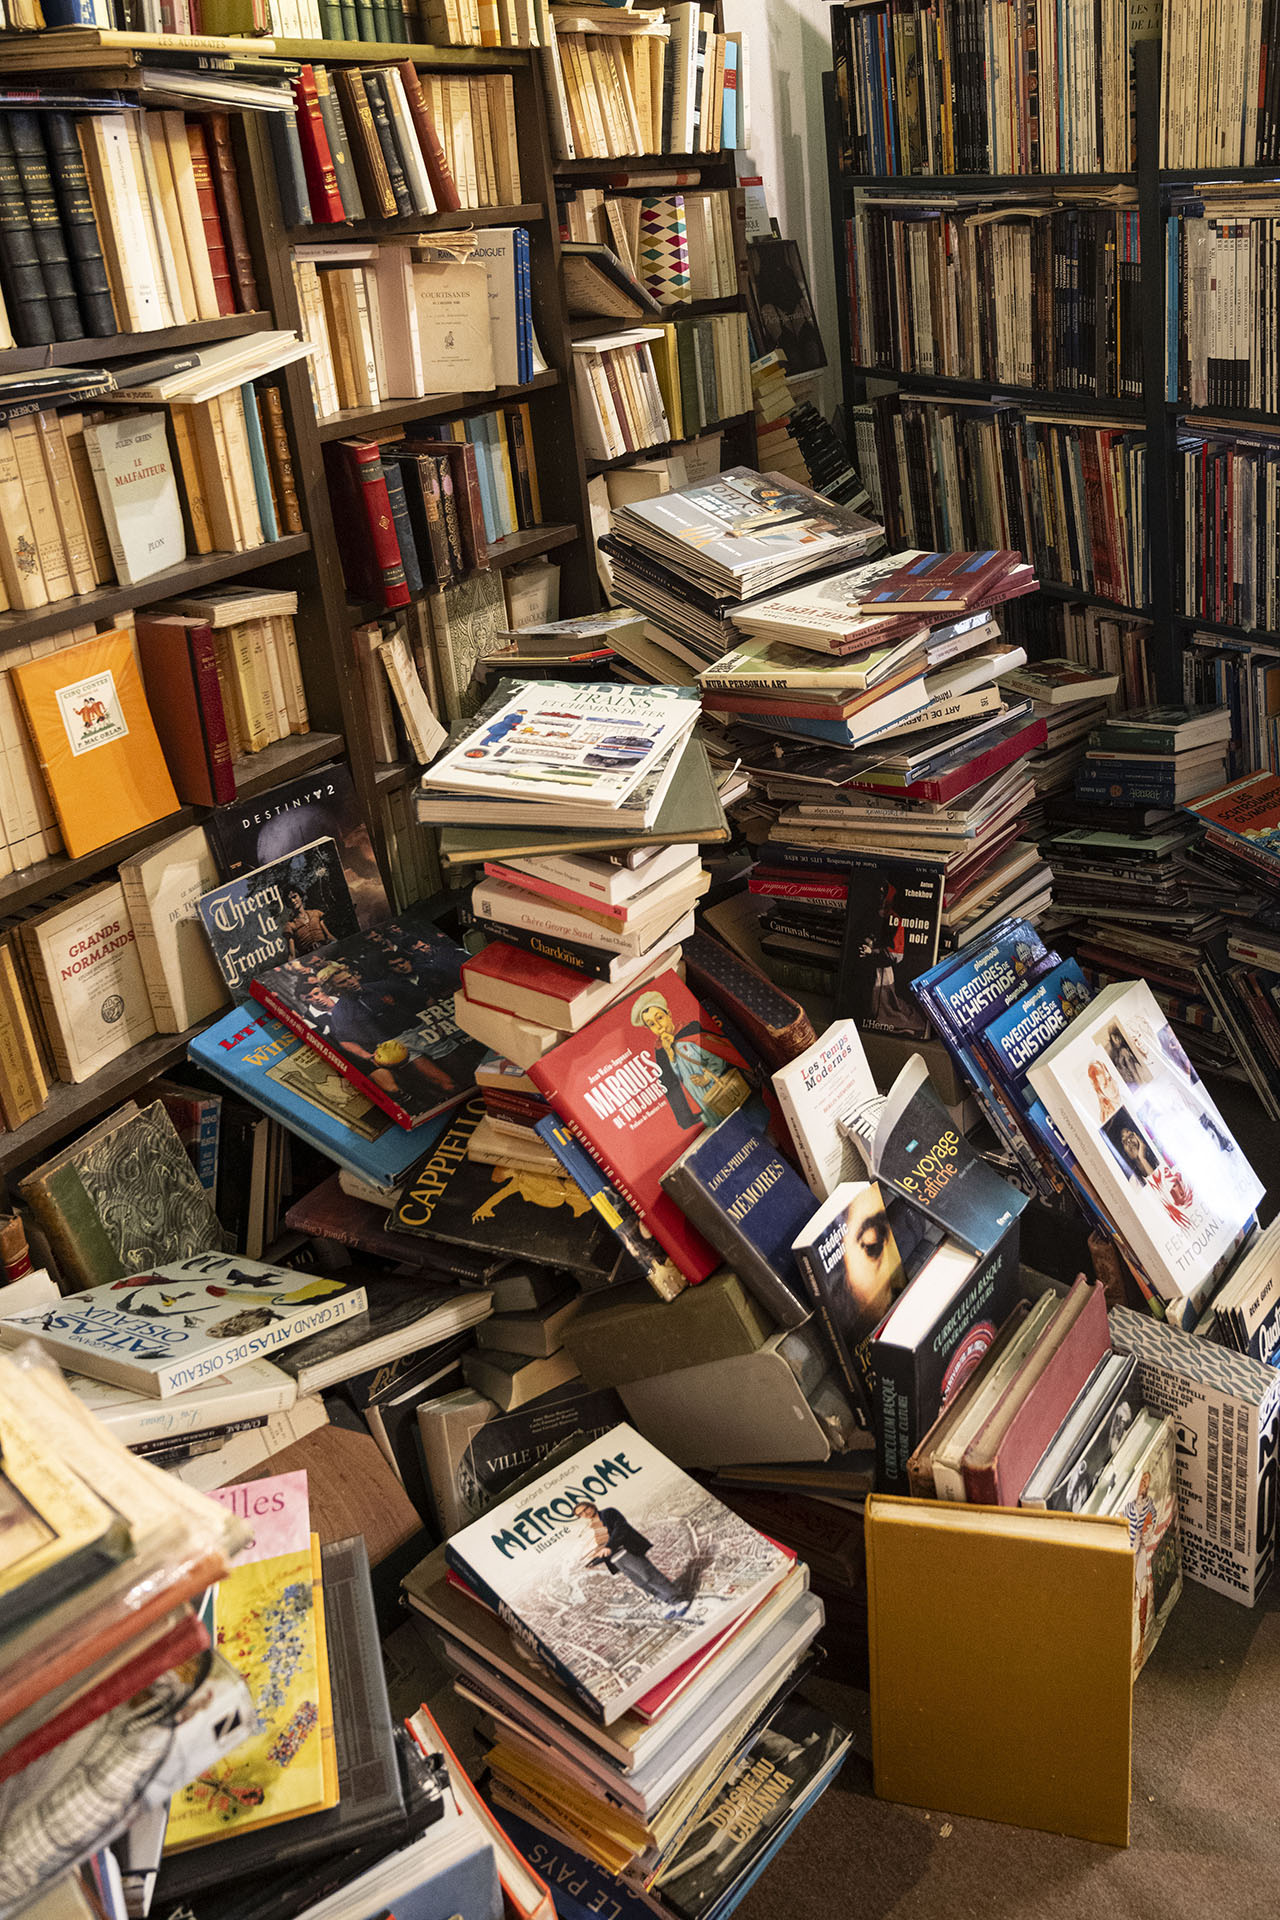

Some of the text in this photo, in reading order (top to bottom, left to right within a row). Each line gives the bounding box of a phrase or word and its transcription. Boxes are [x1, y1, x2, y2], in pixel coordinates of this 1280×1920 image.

[1130, 4, 1149, 16] LES
[1131, 20, 1144, 30] DE
[469, 247, 506, 259] RADIGUET
[7, 402, 41, 420] ROBERT
[115, 432, 153, 449] JULIEN GREEN
[114, 462, 167, 488] MALFAITEUR
[133, 458, 143, 468] LE
[148, 537, 166, 552] PLON
[63, 689, 81, 699] CINQ
[572, 691, 655, 709] TRAINS
[728, 680, 770, 689] PERSONAL
[771, 679, 788, 689] ART
[560, 701, 621, 714] CHEMINS
[931, 704, 961, 719] ART DE
[84, 726, 122, 745] MAC ORLAN
[241, 783, 336, 830] DESTINY 2
[208, 884, 285, 932] Thierry
[904, 888, 934, 900] Tchekhov
[68, 920, 121, 959] GRANDS
[256, 912, 279, 936] la
[521, 913, 545, 929] Chère
[544, 920, 572, 936] George
[572, 926, 594, 941] Sand
[769, 920, 811, 939] Carnavals
[888, 915, 930, 931] Le moine
[908, 932, 929, 945] noir
[60, 929, 136, 982] NORMANDS
[222, 934, 287, 990] Fronde
[530, 936, 586, 969] Chardonne
[949, 960, 1011, 1009] AVENTURES DE
[1000, 1000, 1058, 1052] AVENTURES DE
[1007, 1008, 1067, 1069] L'HISTOIRE
[800, 1033, 850, 1082] Les Temps
[804, 1044, 854, 1092] Modernes
[583, 1049, 665, 1121] MARQUES
[612, 1113, 626, 1130] DE
[622, 1079, 669, 1123] TOUJOURS
[399, 1096, 488, 1227] CAPPIELLO
[707, 1136, 761, 1193] LOUIS-PHILIPPE
[893, 1130, 960, 1194] le voyage
[725, 1157, 787, 1226] MÉMOIRES
[917, 1162, 959, 1206] s'affiche
[817, 1221, 849, 1261] Frédéric
[1174, 1222, 1222, 1273] TITOUAN
[822, 1241, 848, 1275] Lenoir
[932, 1283, 979, 1354] CURRICULUM
[975, 1254, 1004, 1302] BASQUE
[49, 1312, 172, 1354] ATLAS
[74, 1304, 190, 1343] OISEAUX
[168, 1300, 348, 1389] LE GRAND ATLAS DES OISEAUX
[1160, 1369, 1191, 1387] DONT ON
[1170, 1388, 1179, 1397] ET
[1171, 1381, 1206, 1401] S'APPELLE
[485, 1444, 533, 1475] VILLE
[489, 1451, 645, 1561] METRONOME
[532, 1523, 572, 1556] illustré
[1204, 1537, 1233, 1559] PARI
[1186, 1538, 1249, 1575] INNOVANT
[1199, 1552, 1241, 1579] DE SES
[1201, 1562, 1250, 1593] QUATRE
[708, 1756, 776, 1832] DOISNEAU
[727, 1770, 796, 1846] CAVANNA
[526, 1842, 624, 1920] LE PAYS
